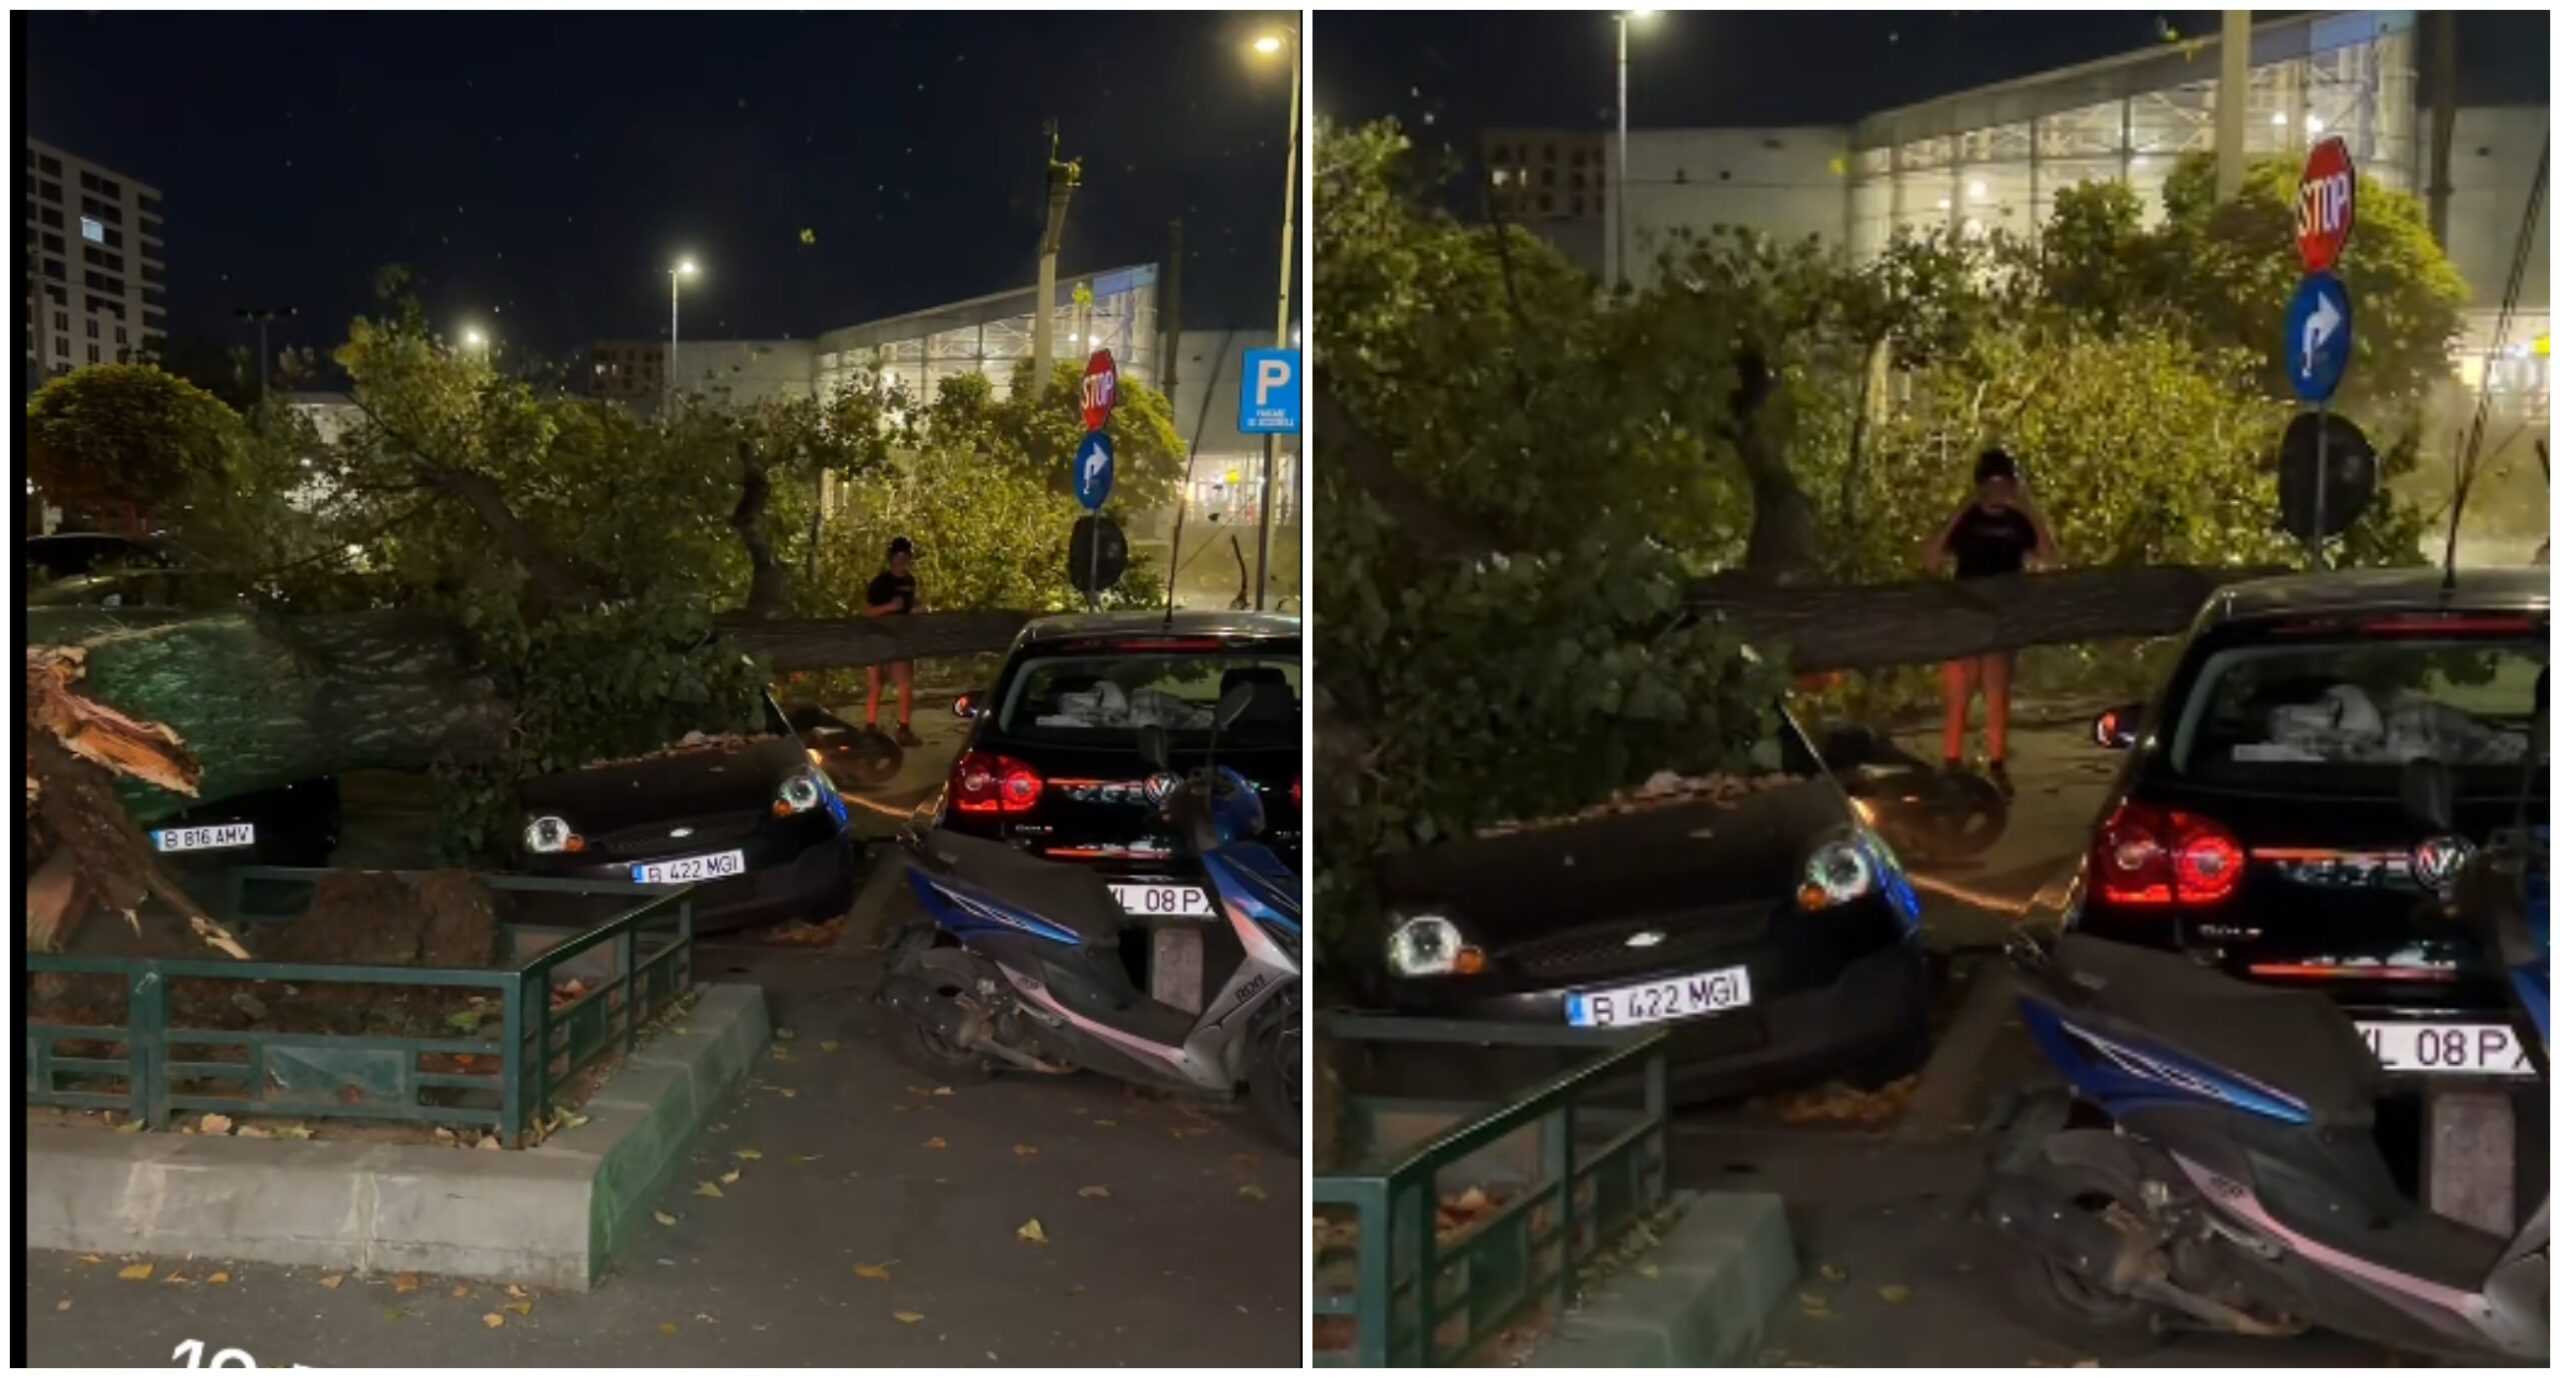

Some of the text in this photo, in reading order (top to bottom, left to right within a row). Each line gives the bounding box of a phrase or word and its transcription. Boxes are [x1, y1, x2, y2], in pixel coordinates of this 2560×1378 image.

[2298, 172, 2348, 237] STOP
[1081, 370, 1113, 409] STOP
[1256, 359, 1291, 405] P
[165, 830, 178, 849] B
[184, 828, 211, 847] 816
[648, 855, 738, 882] B 422 MGI
[1112, 887, 1134, 911] L
[1146, 889, 1176, 912] 08
[1593, 975, 1739, 1025] B 422 MGI
[2361, 1028, 2399, 1065] L
[2418, 1029, 2467, 1066] 08
